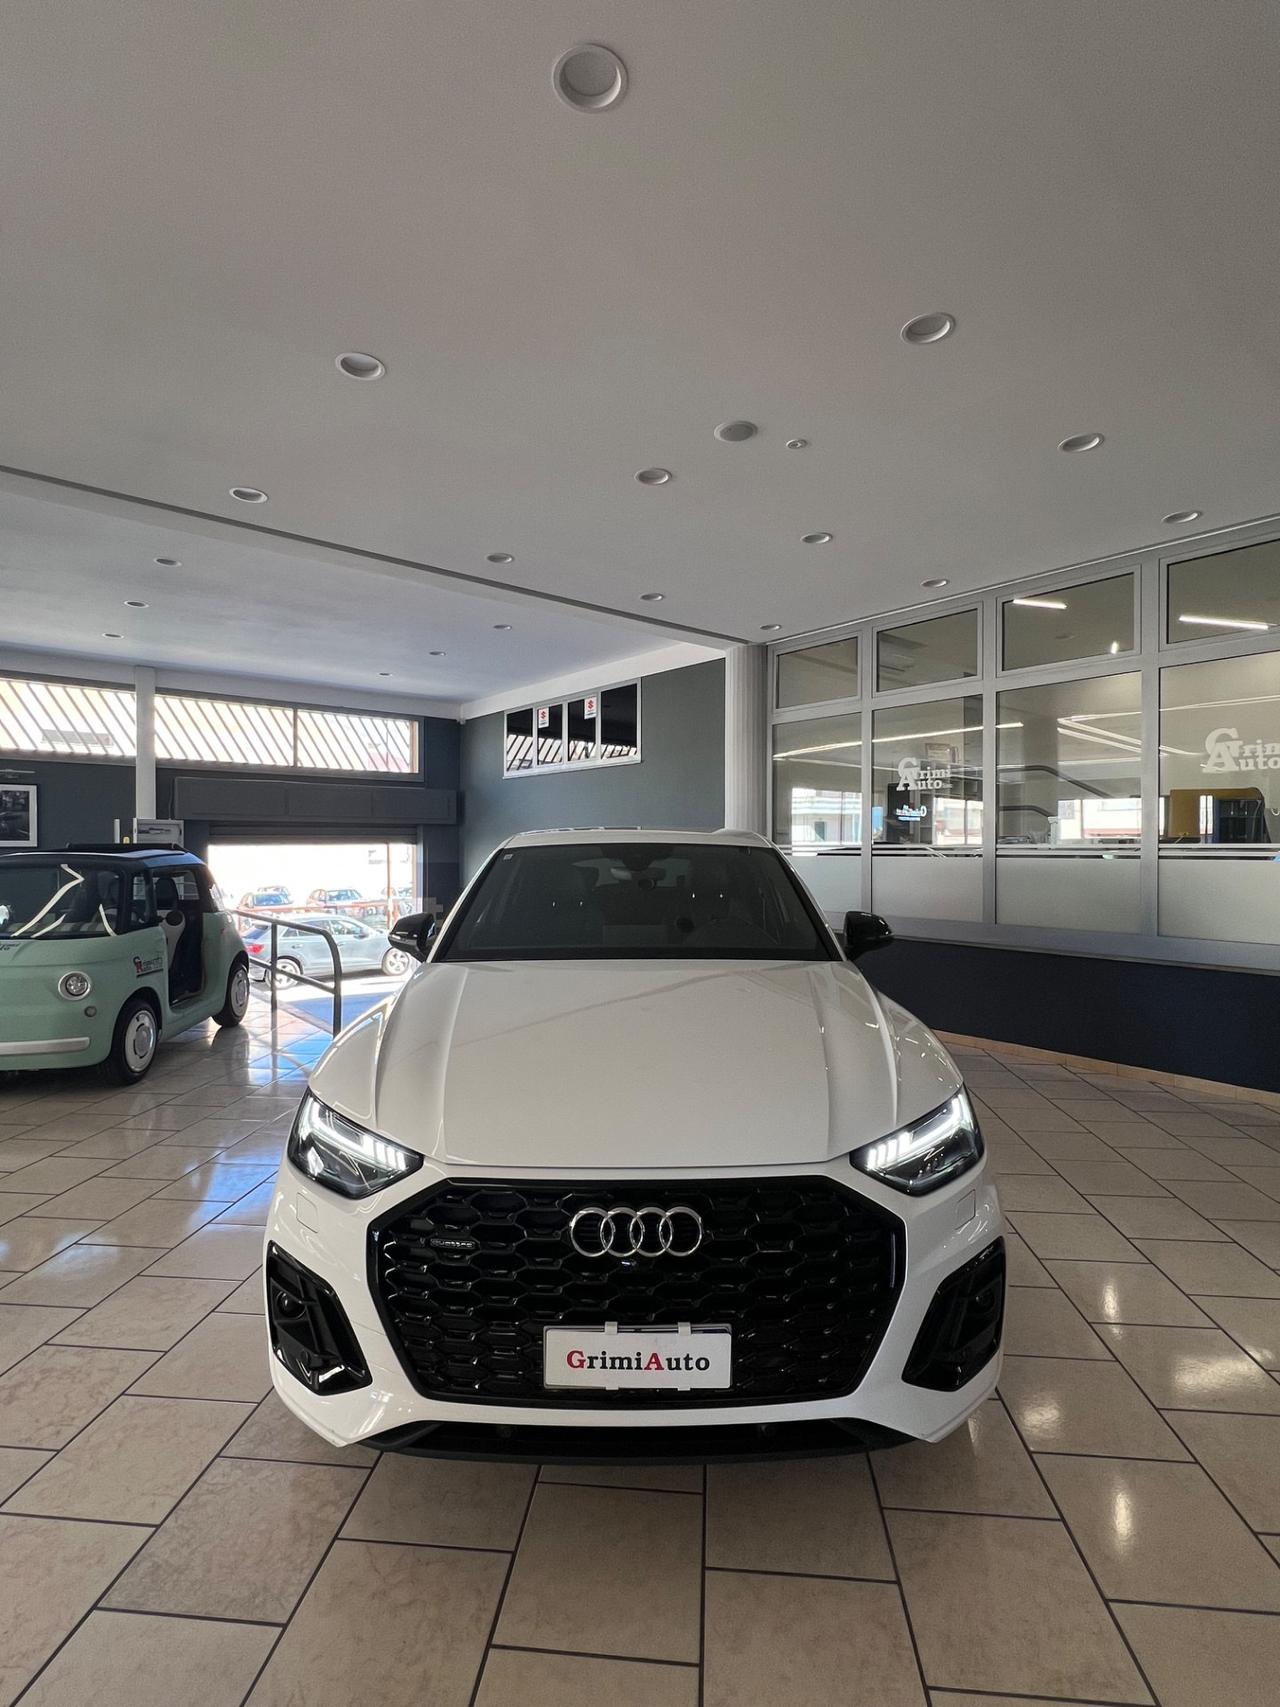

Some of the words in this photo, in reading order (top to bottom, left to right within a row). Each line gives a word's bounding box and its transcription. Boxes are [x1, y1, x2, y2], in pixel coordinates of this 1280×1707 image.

[896, 768, 943, 791] Auto
[898, 757, 952, 780] Grimi
[566, 1350, 710, 1371] GrimiAuto
